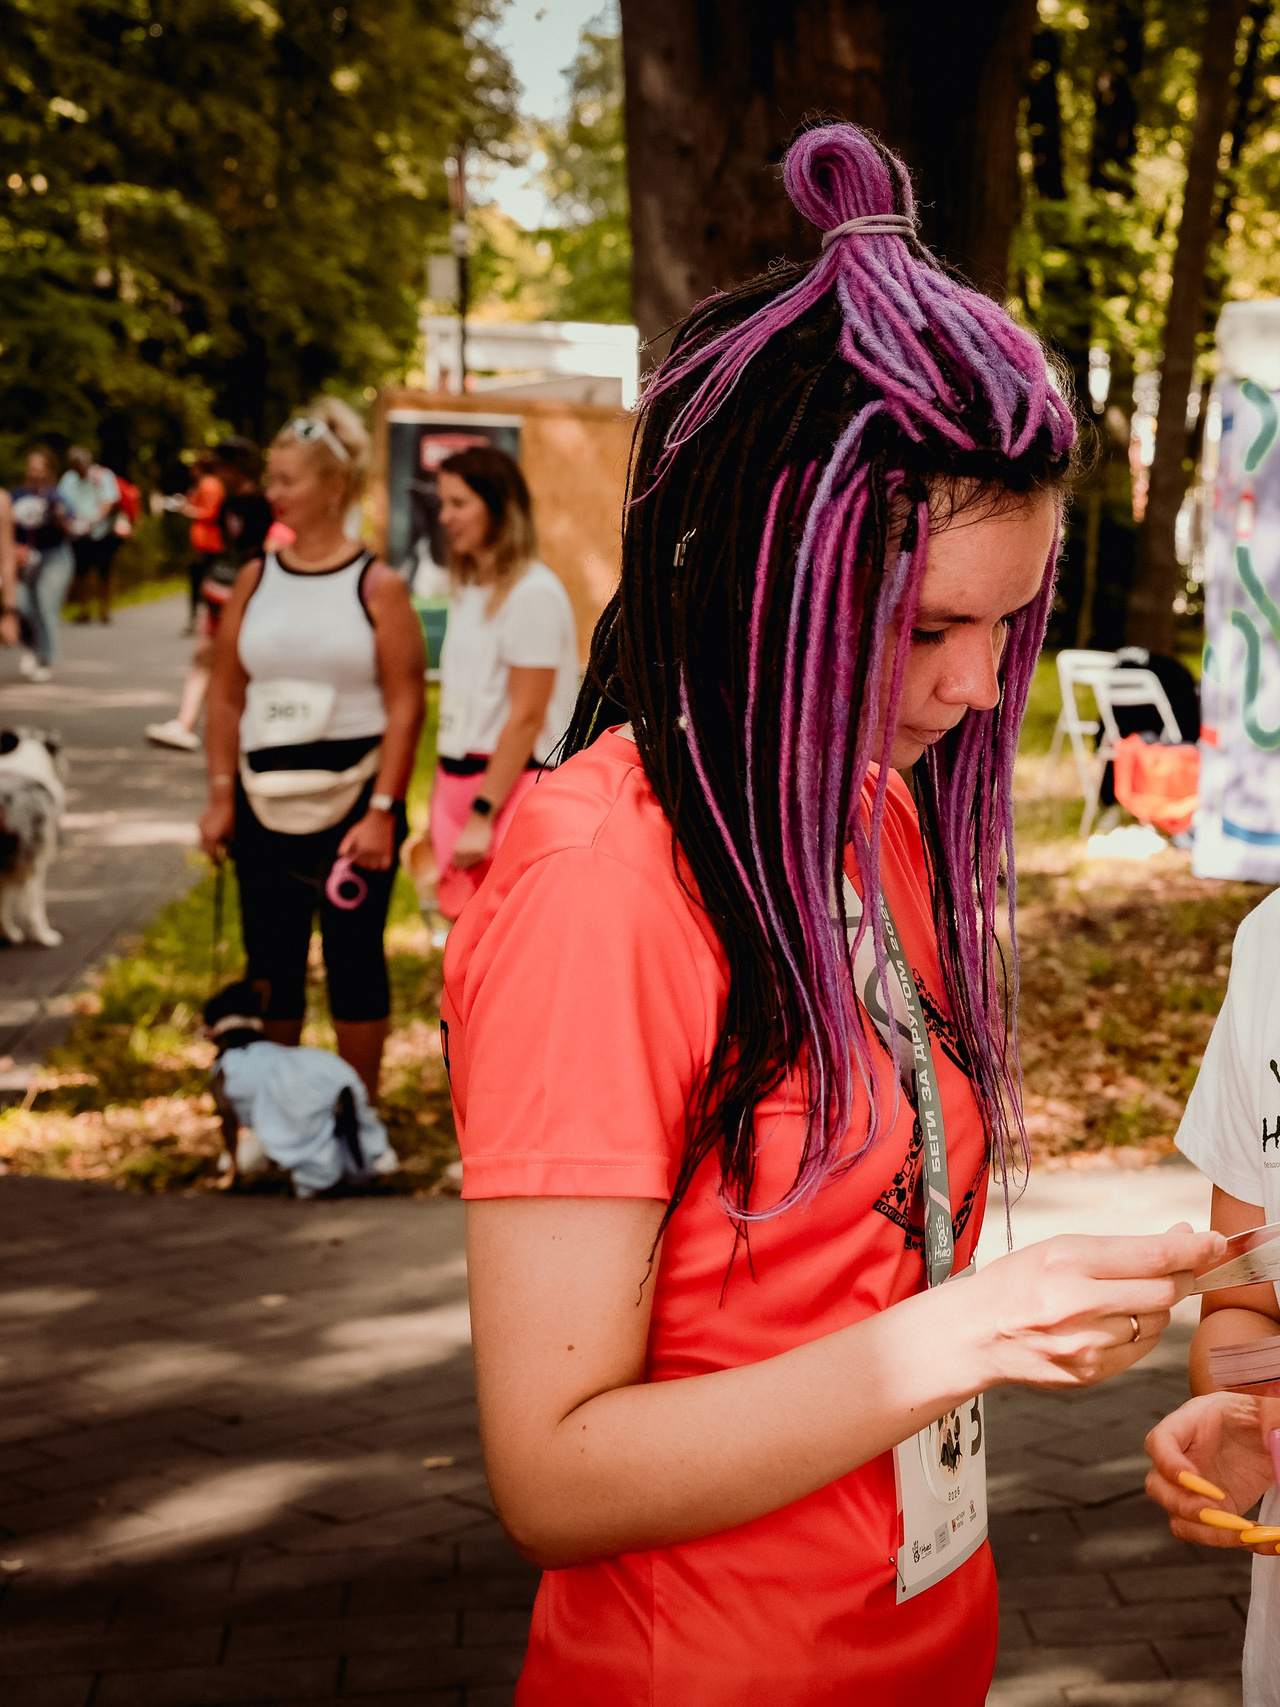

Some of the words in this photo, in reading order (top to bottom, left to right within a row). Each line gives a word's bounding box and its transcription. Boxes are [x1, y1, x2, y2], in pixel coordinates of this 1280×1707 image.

[896, 960, 927, 1062] ДРУГОМ
[919, 1069, 932, 1102] ЗА
[925, 1110, 941, 1173] БЕГИ
